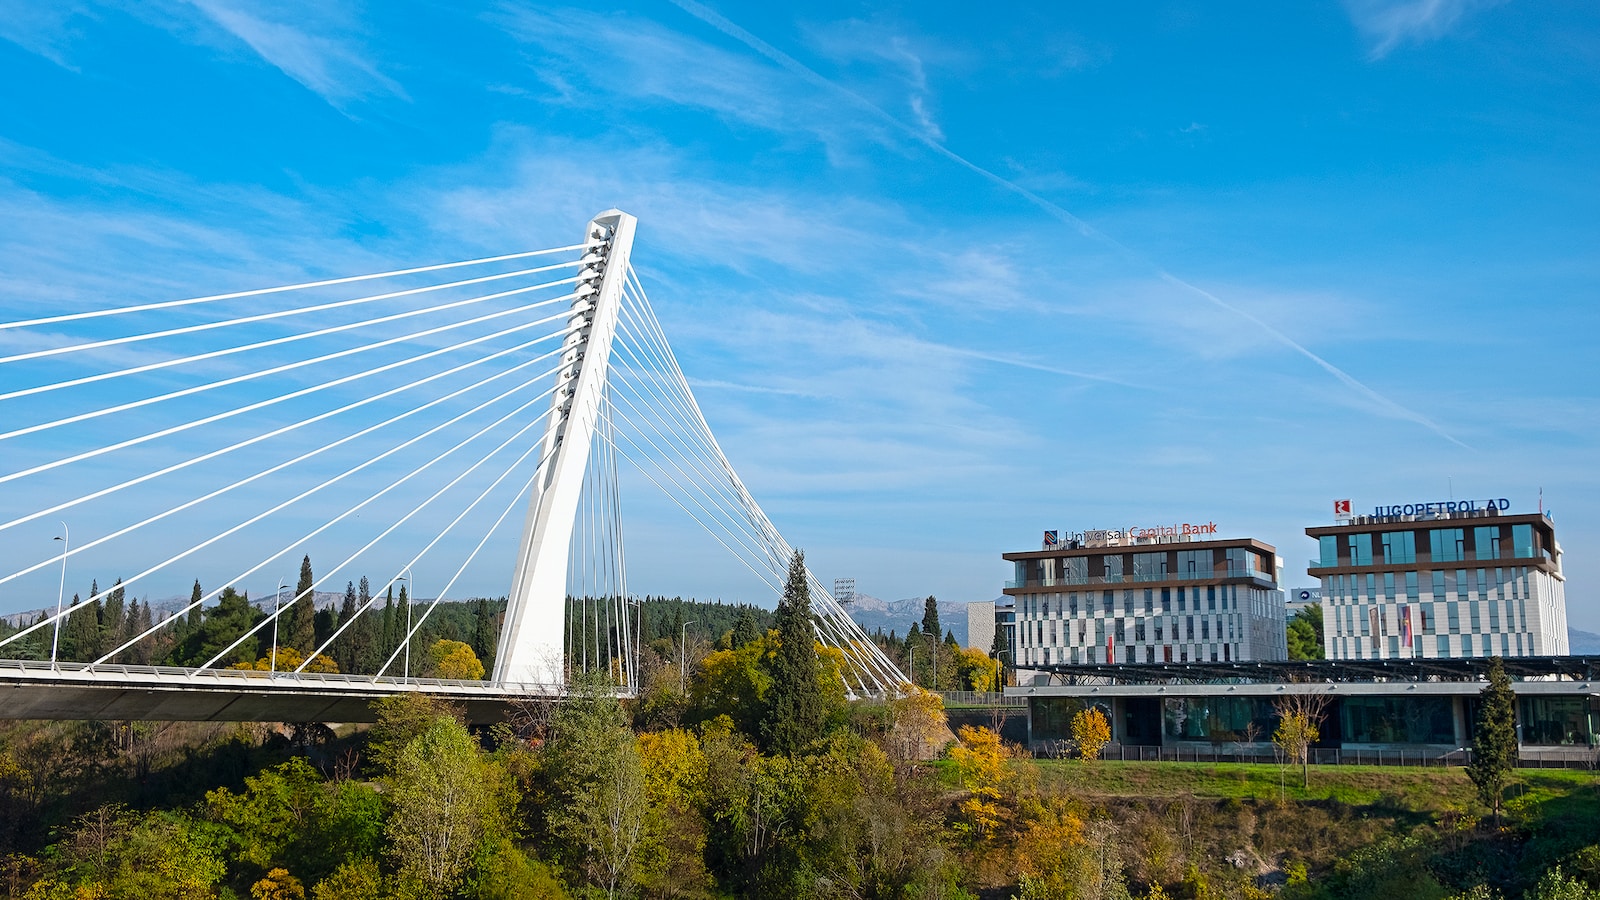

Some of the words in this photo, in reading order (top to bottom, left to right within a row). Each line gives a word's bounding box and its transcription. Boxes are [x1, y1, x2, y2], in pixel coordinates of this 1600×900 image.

[1369, 500, 1480, 519] JUGOPETROL
[1486, 498, 1510, 511] AD
[1065, 527, 1126, 543] Universal
[1129, 524, 1177, 541] Capital
[1182, 521, 1217, 535] Bank
